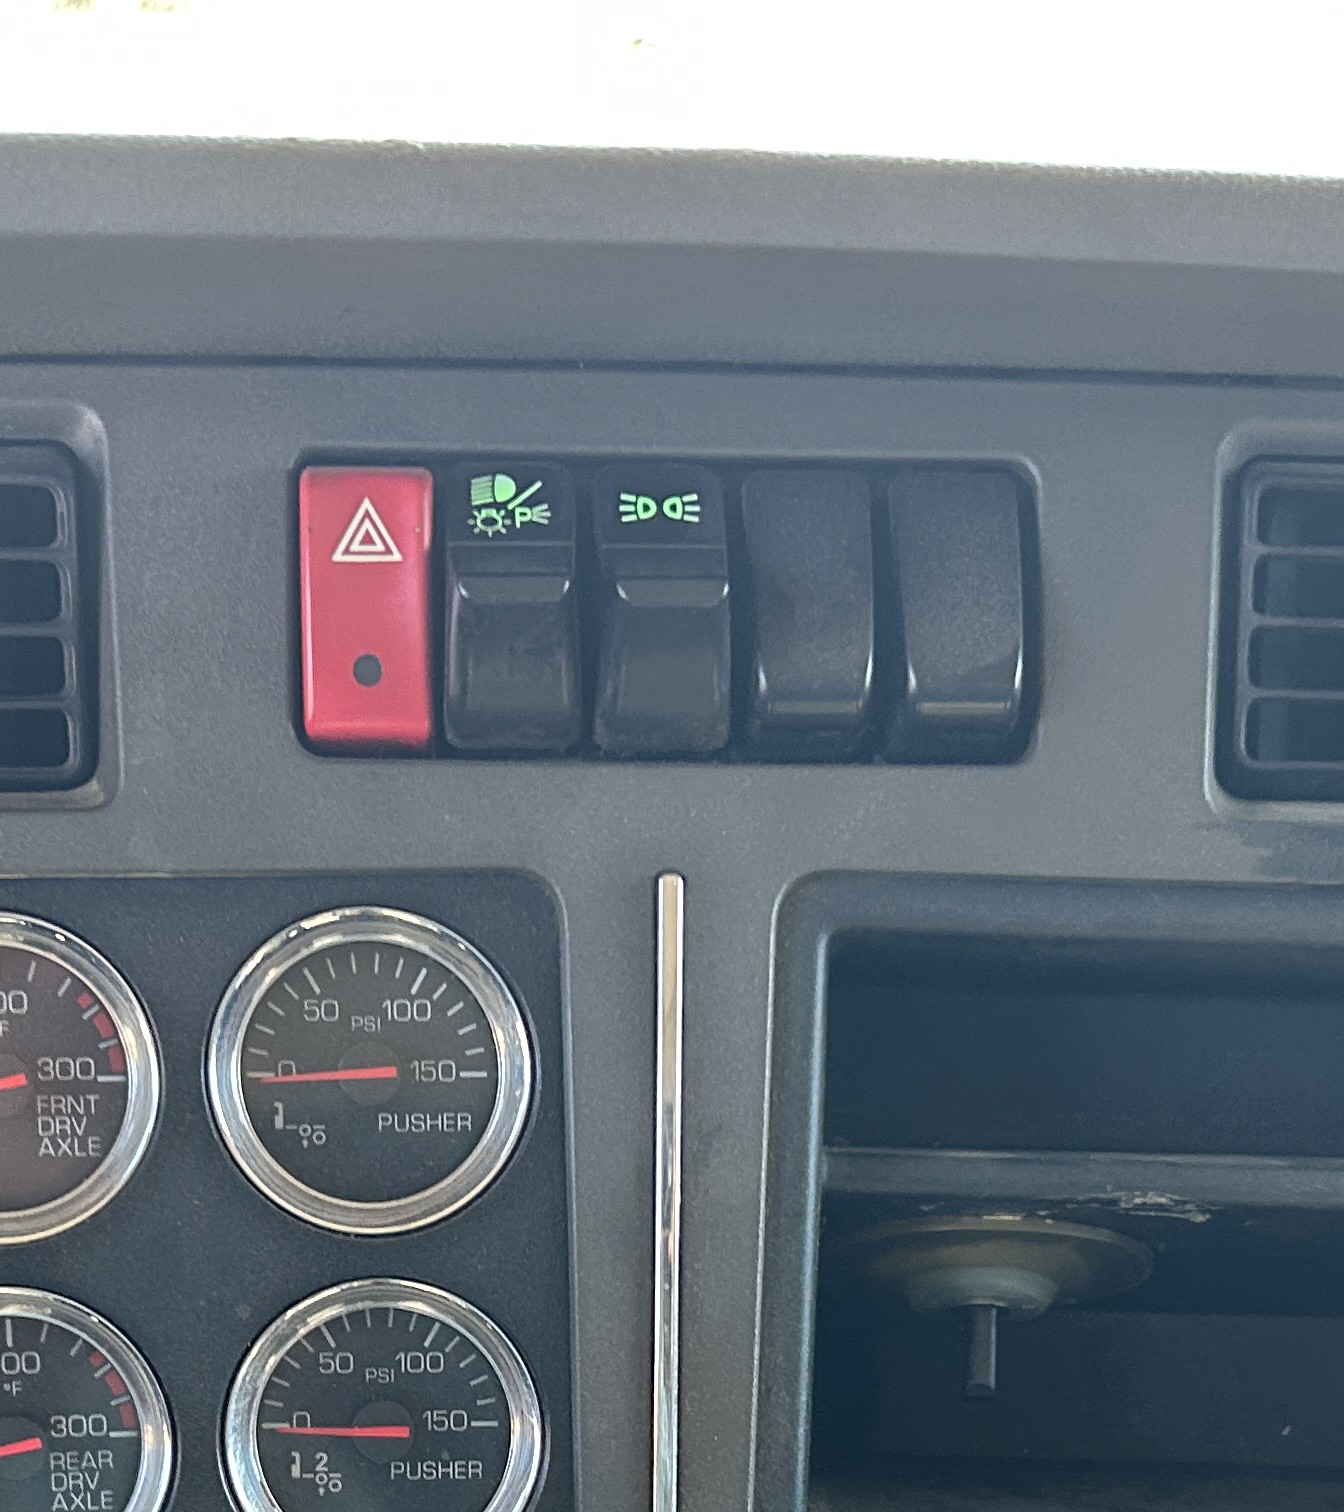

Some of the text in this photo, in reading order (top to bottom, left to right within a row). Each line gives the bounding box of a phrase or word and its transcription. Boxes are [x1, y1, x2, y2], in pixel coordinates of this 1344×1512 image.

[303, 999, 339, 1022] 50
[382, 999, 431, 1022] 100
[351, 1016, 381, 1032] PSI
[37, 1058, 95, 1082] 300
[410, 1060, 456, 1083] 150
[37, 1095, 100, 1115] FRNT
[38, 1116, 87, 1136] DRV
[378, 1112, 472, 1133] PUSHER
[38, 1137, 102, 1157] AXLE
[318, 1352, 354, 1374] 50
[395, 1352, 444, 1374] 100
[365, 1368, 394, 1383] PSI
[3, 1381, 23, 1397] °F
[51, 1414, 108, 1438] 300
[422, 1410, 468, 1432] 150
[50, 1451, 113, 1471] REAR
[315, 1452, 329, 1472] 2
[391, 1460, 483, 1480] PUSHER
[51, 1472, 99, 1491] DRV
[52, 1492, 114, 1512] AXLE
